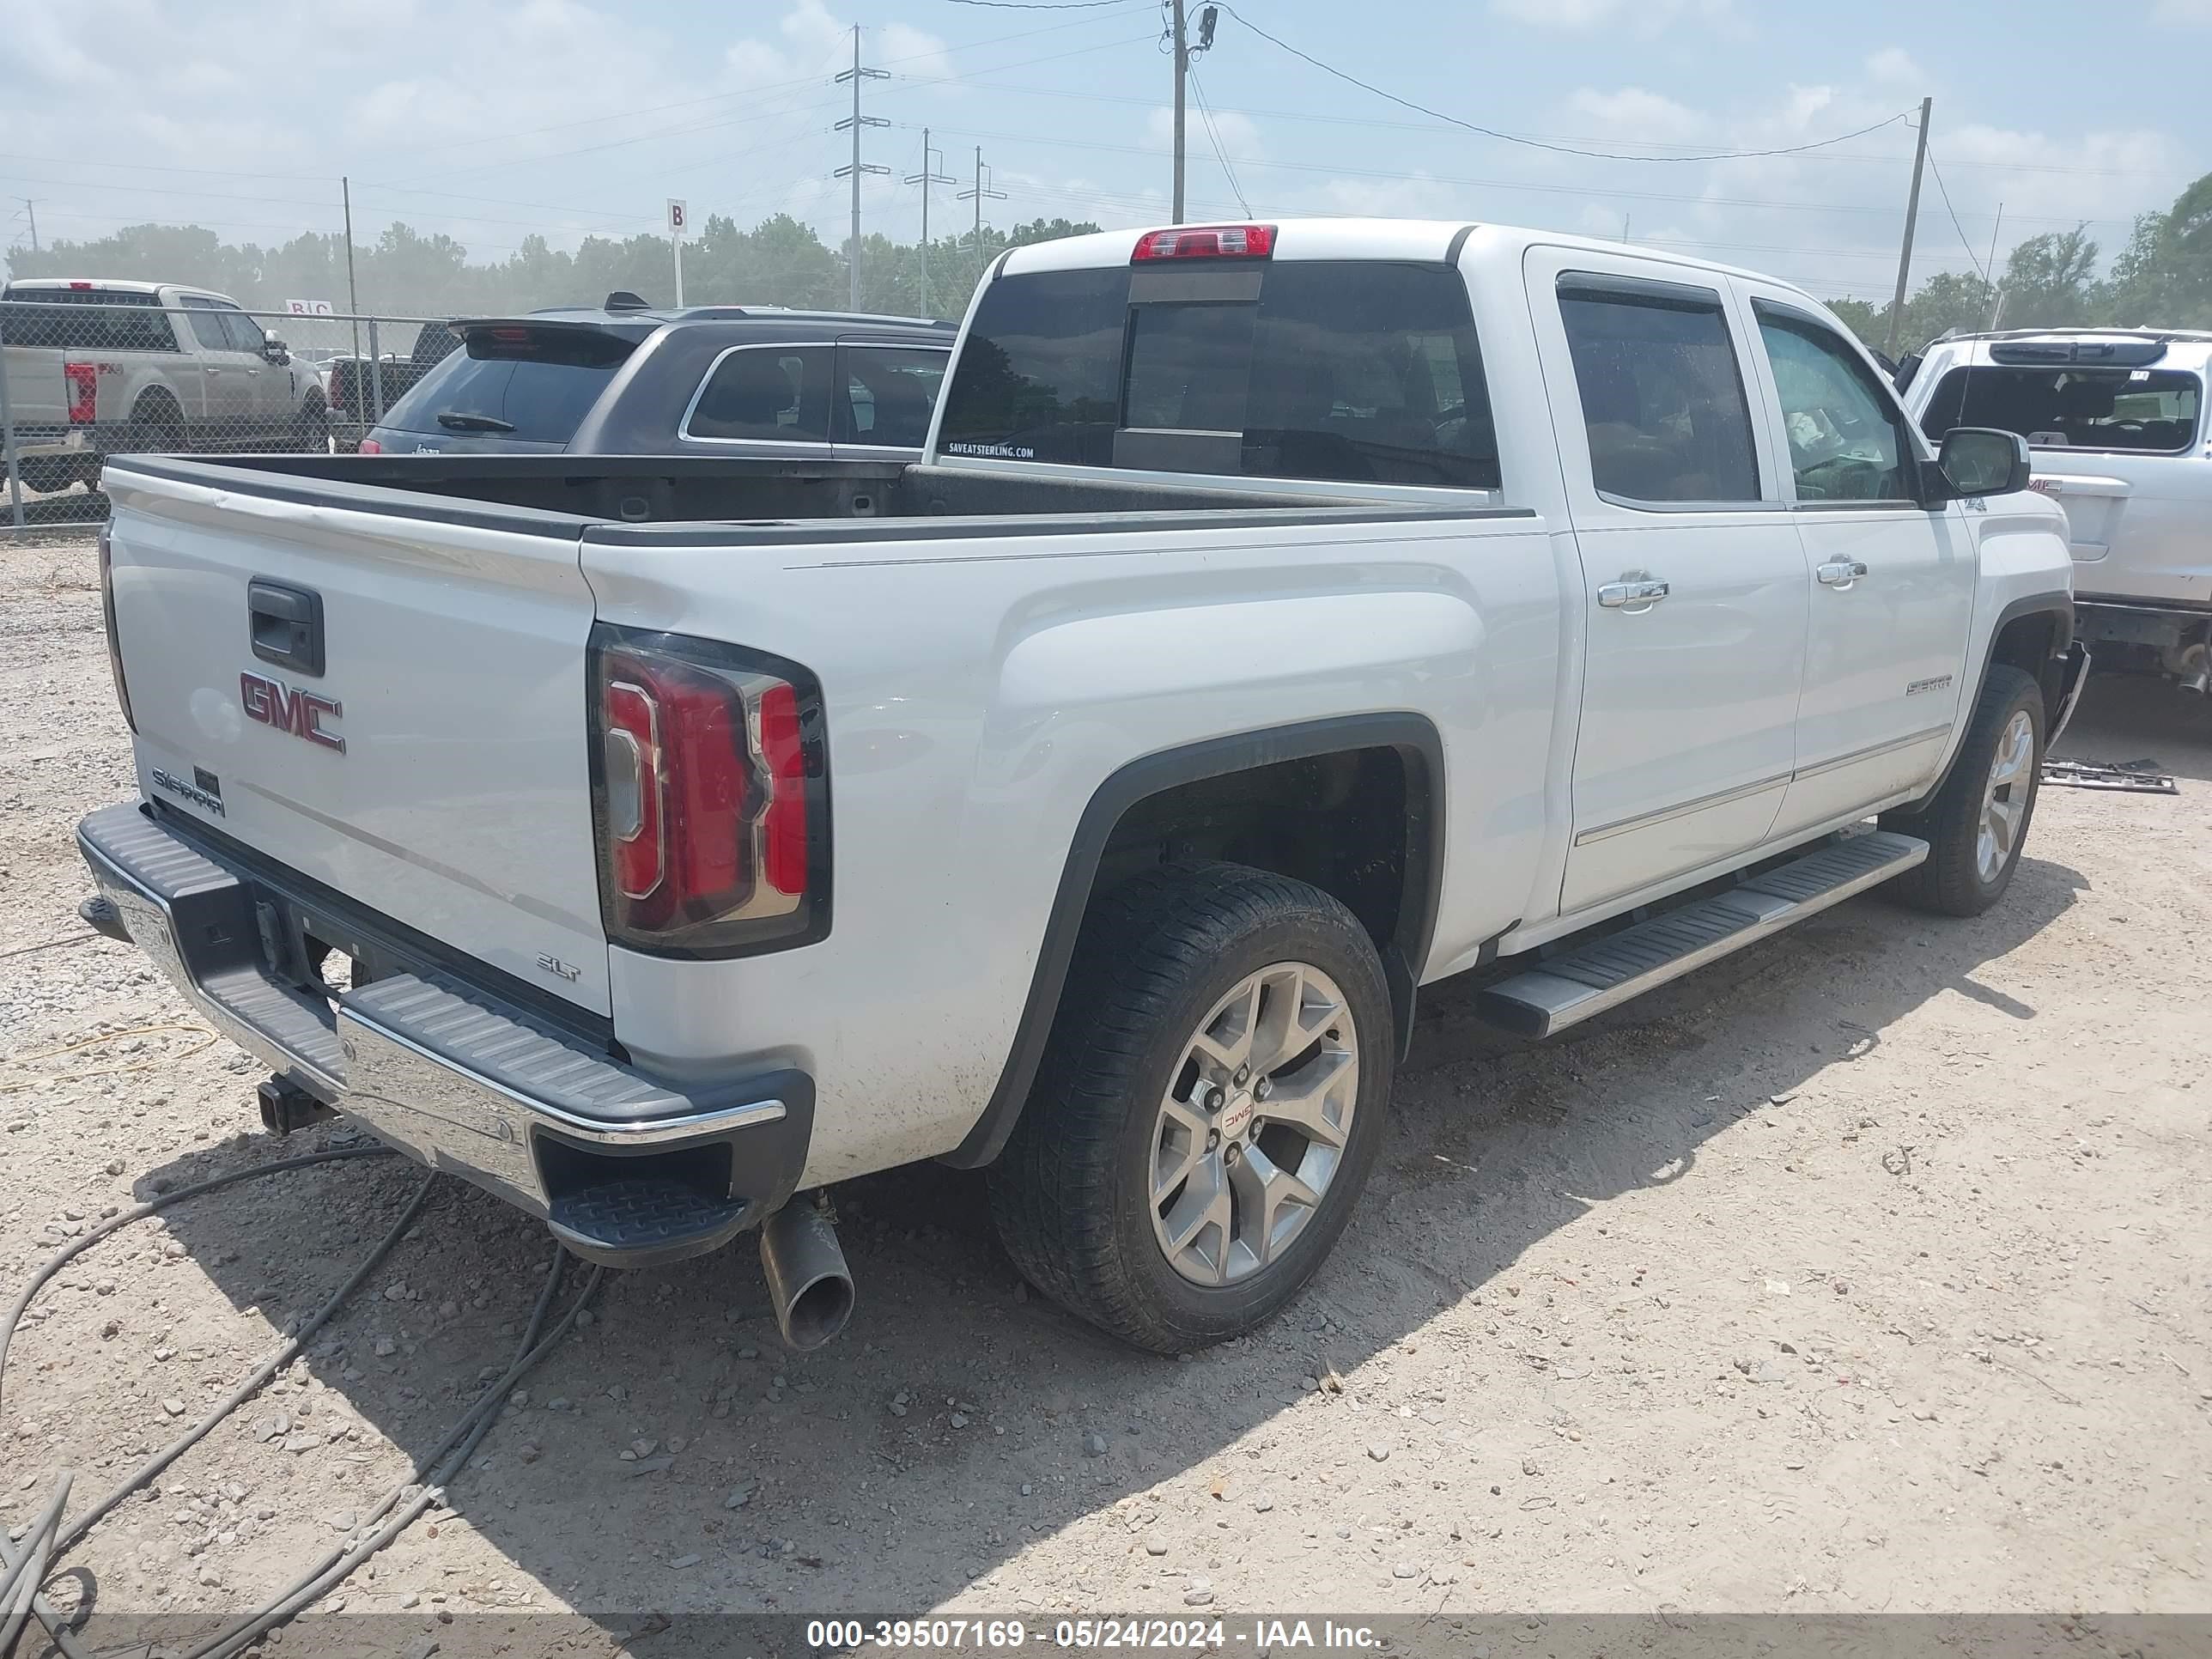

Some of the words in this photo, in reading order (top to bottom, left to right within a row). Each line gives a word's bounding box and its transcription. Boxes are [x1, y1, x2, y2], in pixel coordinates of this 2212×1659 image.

[672, 204, 684, 227] B
[949, 442, 1034, 459] SAVEATSTERLING.COM
[2027, 478, 2063, 492] MC
[240, 669, 347, 756] GMC
[152, 766, 226, 818] SIERRA
[536, 951, 581, 983] SLT
[1224, 1103, 1252, 1127] GMC
